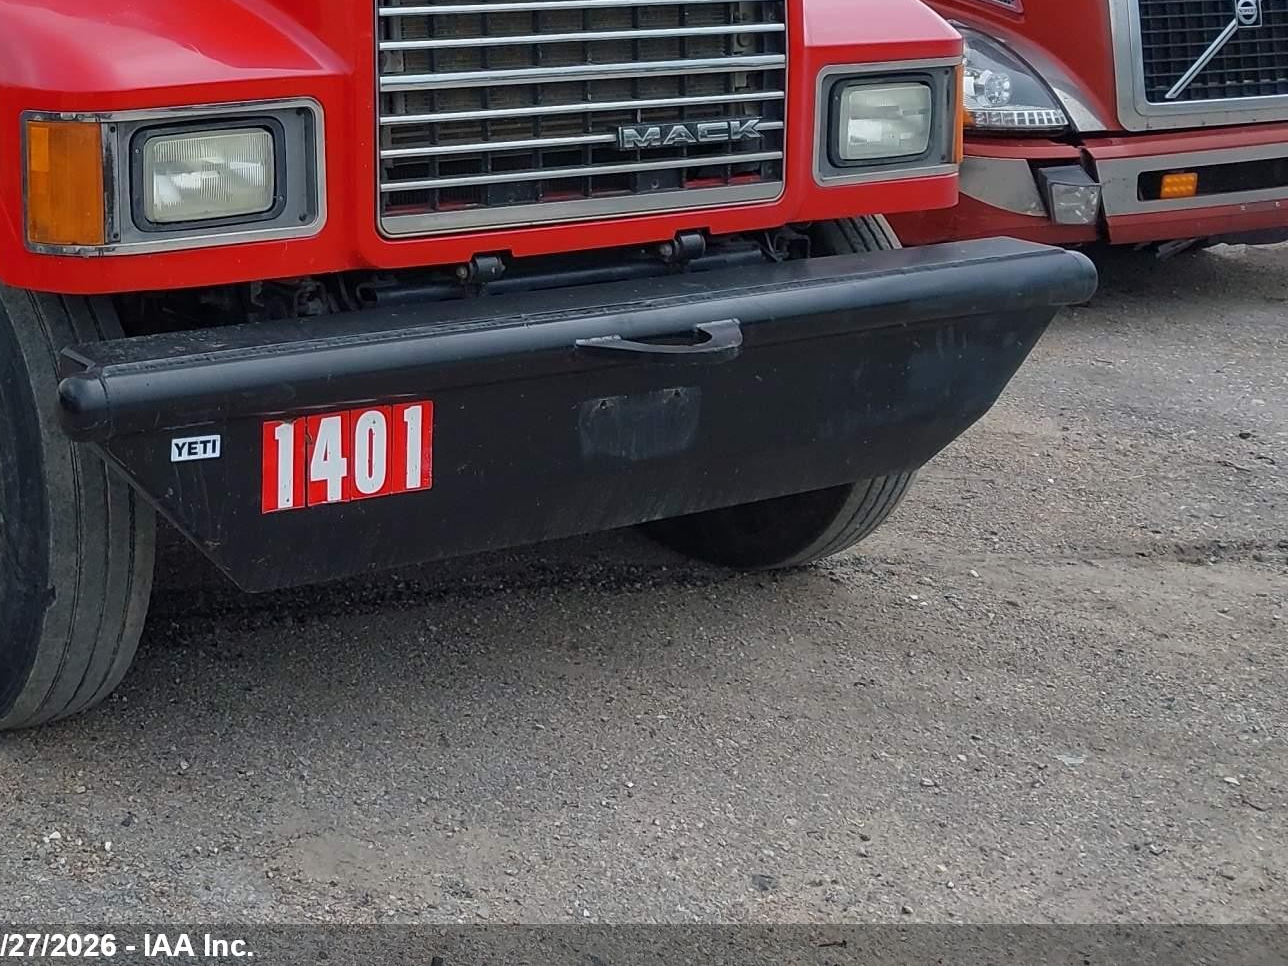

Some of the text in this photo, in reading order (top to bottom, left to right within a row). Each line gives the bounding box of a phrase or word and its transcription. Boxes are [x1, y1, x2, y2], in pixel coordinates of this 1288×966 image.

[623, 119, 762, 148] MACK
[174, 438, 218, 458] YETI
[275, 405, 423, 509] 1401
